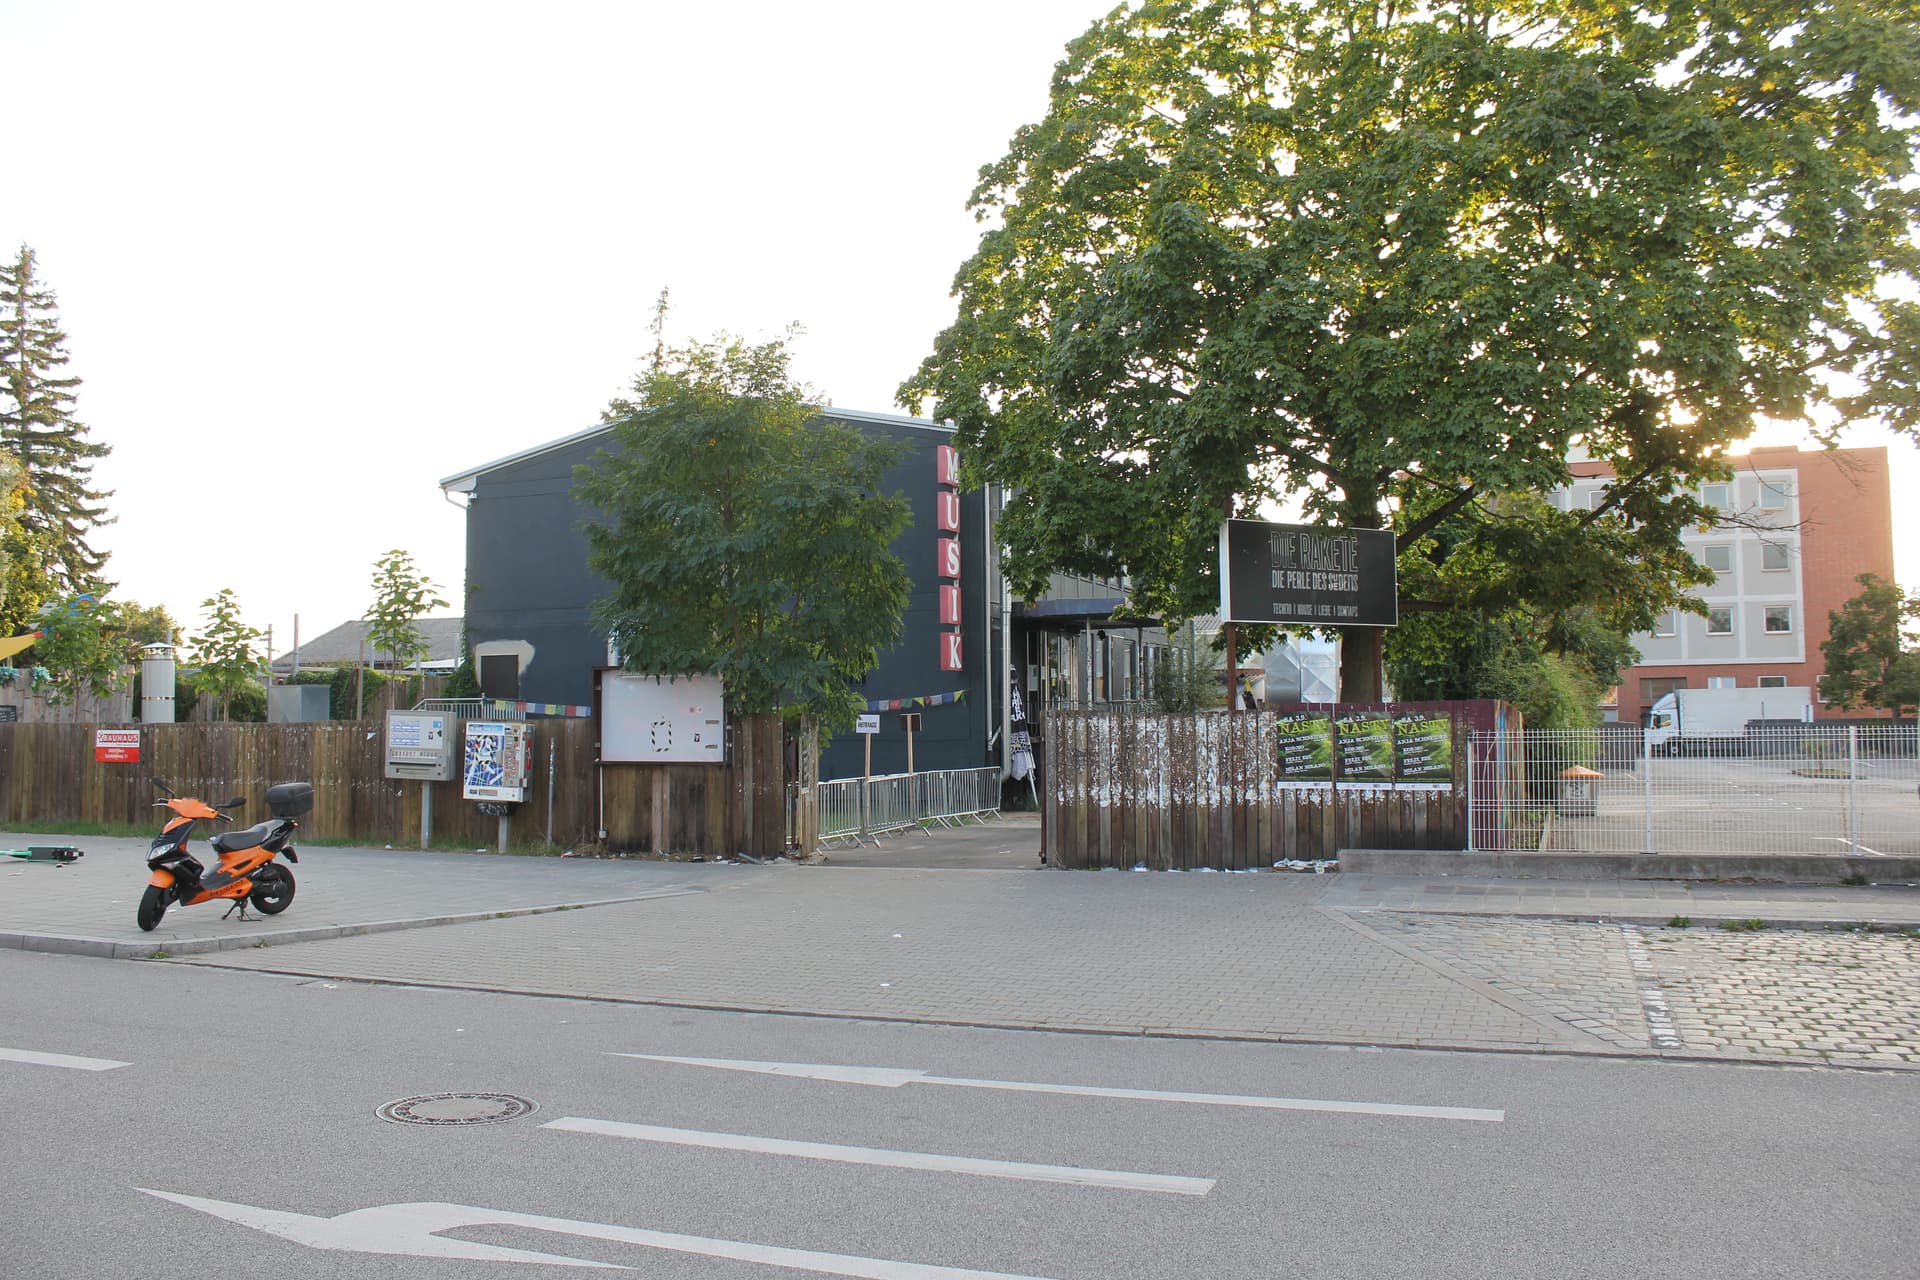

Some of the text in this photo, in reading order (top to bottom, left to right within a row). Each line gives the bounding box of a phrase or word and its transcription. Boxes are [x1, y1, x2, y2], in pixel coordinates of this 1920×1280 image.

[944, 447, 963, 670] MUSIK
[1270, 531, 1360, 573] DIE RAKETE
[1272, 569, 1285, 589] DIE
[1287, 570, 1311, 590] PERLE
[1312, 571, 1328, 592] DES
[1279, 718, 1329, 735] NASTY
[1340, 719, 1390, 736] NASTY
[1396, 718, 1449, 736] NASTY
[102, 733, 139, 743] BAUHAUS
